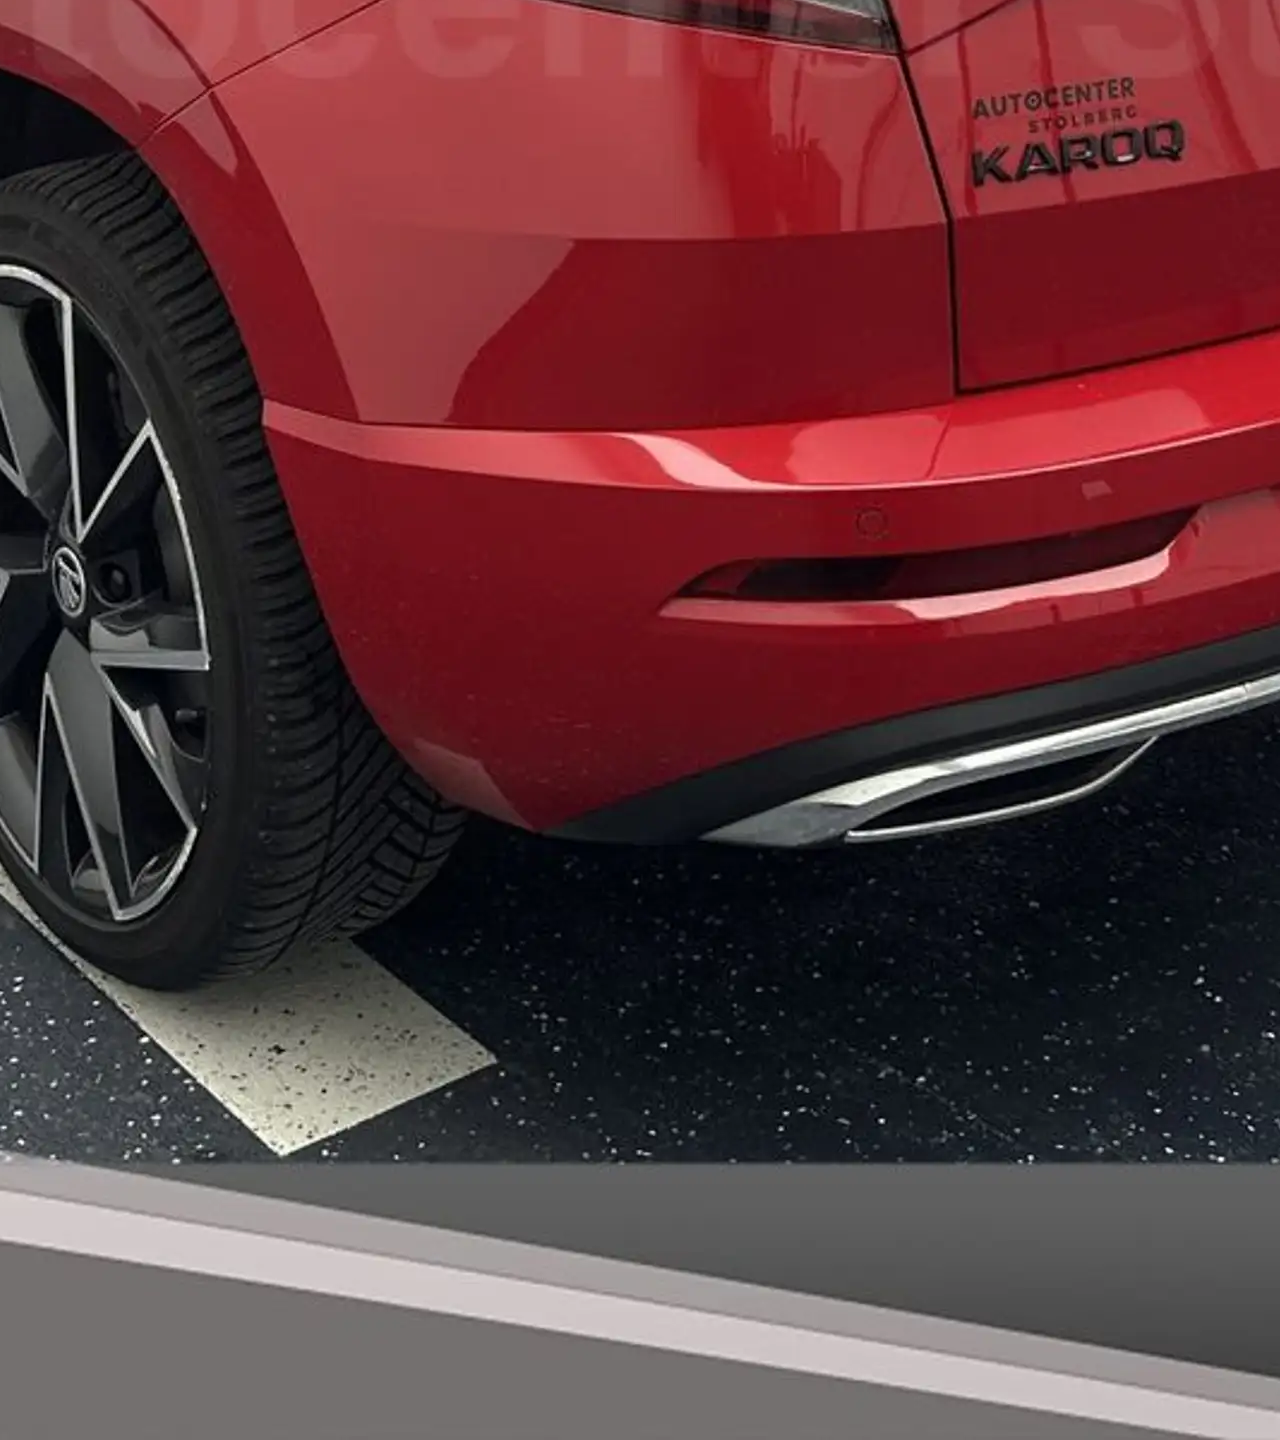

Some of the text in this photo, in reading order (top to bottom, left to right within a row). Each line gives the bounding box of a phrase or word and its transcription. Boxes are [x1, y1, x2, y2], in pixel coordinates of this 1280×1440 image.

[972, 76, 1136, 120] AUTOCENTER
[1027, 104, 1138, 134] STOLBERG
[970, 118, 1186, 188] KAROQ
